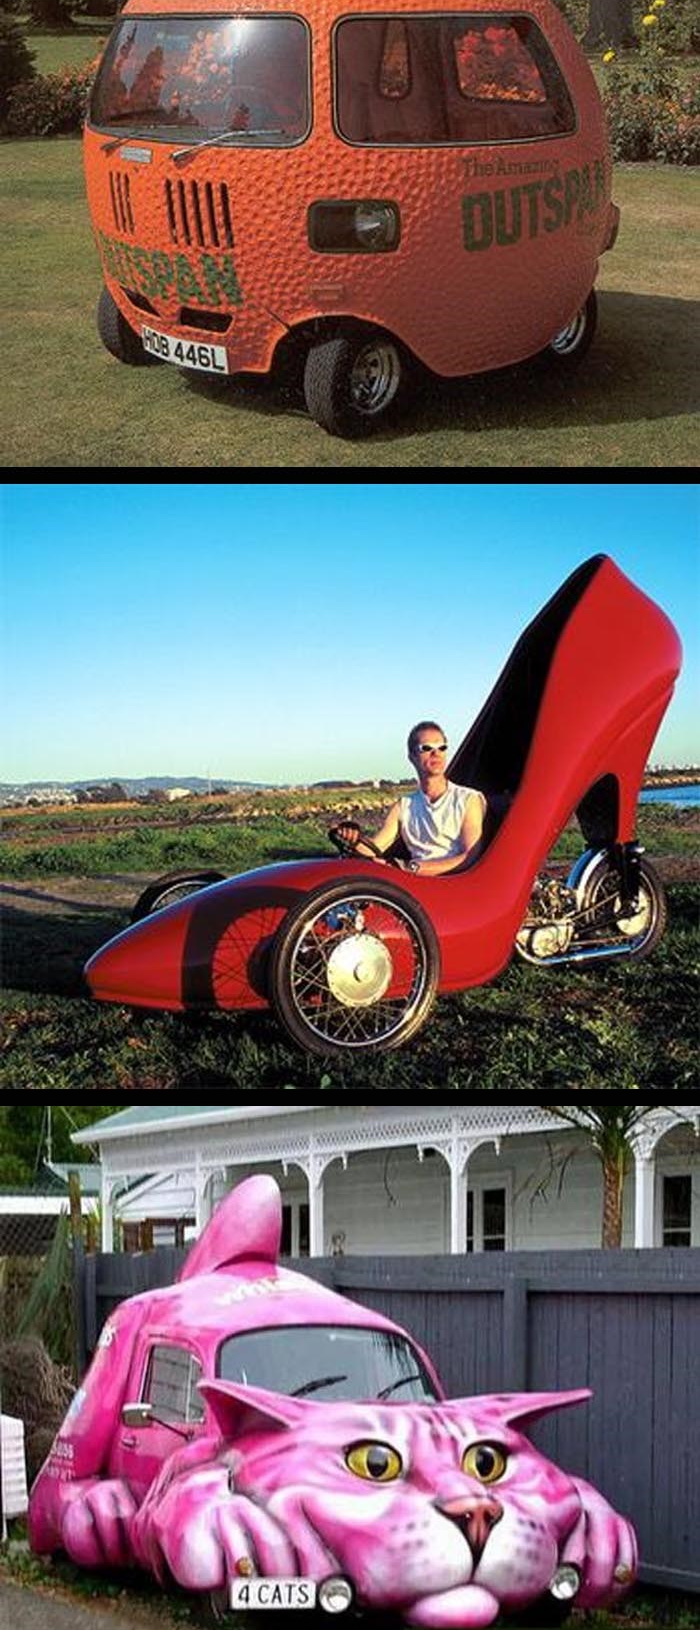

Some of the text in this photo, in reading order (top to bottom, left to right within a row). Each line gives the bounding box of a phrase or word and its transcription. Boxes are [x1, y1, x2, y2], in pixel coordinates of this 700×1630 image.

[174, 341, 226, 370] 446L
[238, 1583, 309, 1605] 4 CATS
